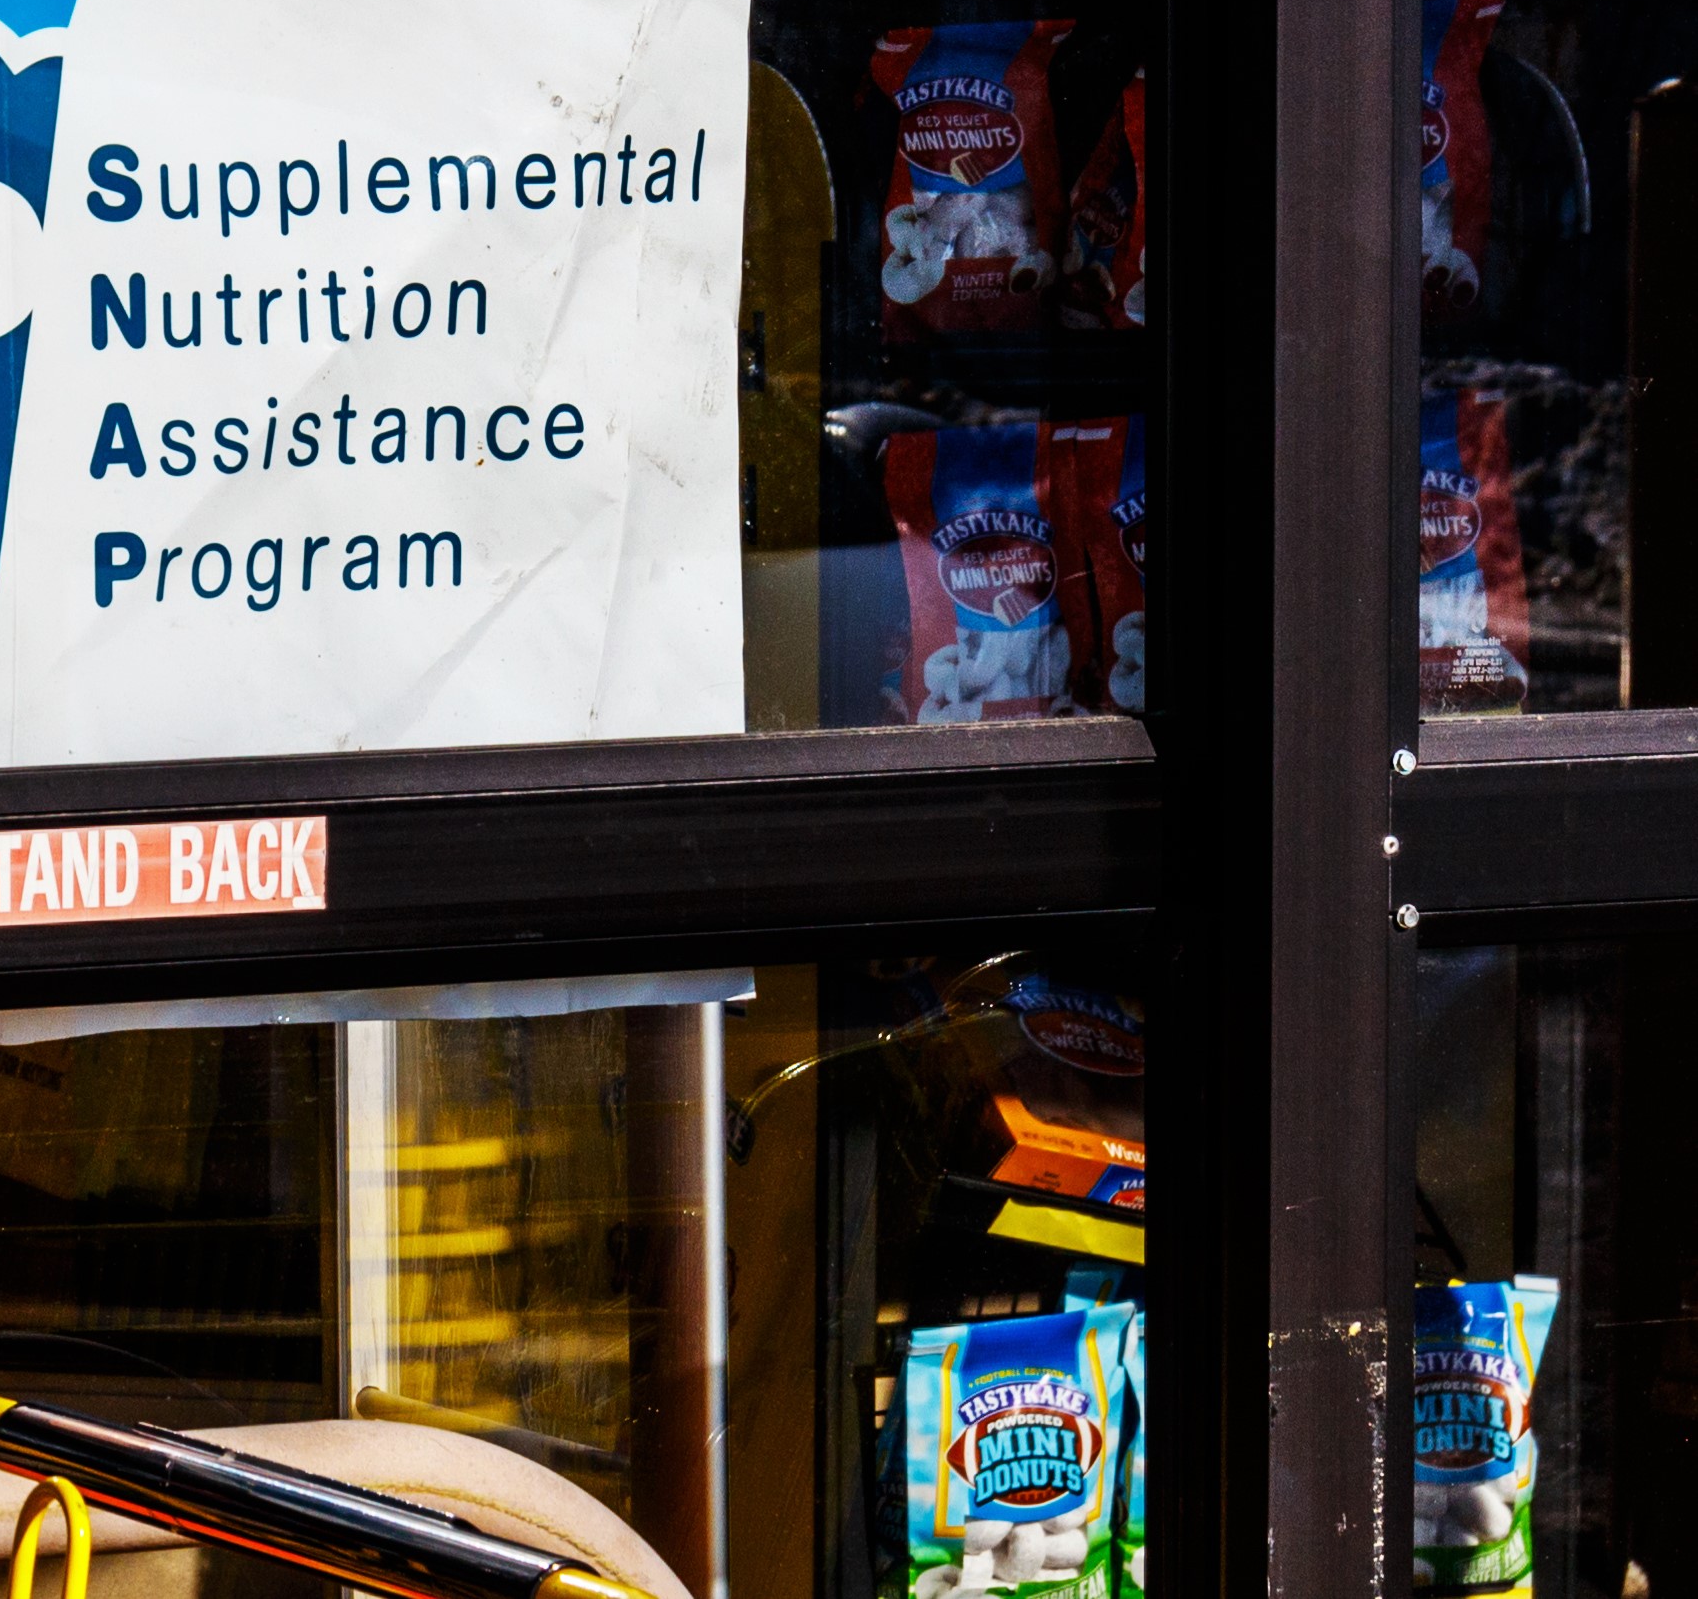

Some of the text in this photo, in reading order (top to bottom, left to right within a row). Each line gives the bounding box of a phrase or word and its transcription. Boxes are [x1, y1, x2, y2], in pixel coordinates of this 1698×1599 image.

[893, 77, 1010, 112] TASTYKAKE
[904, 126, 1016, 152] MINI DONUTS
[916, 112, 990, 128] RED VELVET
[86, 129, 706, 237] Supplemental
[952, 271, 1004, 288] WINTER
[90, 266, 488, 351] Nutrition
[89, 393, 586, 479] Assistance
[934, 512, 1051, 550] TASTYKAKE
[94, 531, 462, 612] Program
[951, 562, 1052, 590] MINI DONUTS
[169, 818, 317, 905] BACK
[960, 1383, 1087, 1424] TASTYKAKE
[987, 1413, 1064, 1434] POWDERED
[978, 1426, 1078, 1469] MINI
[974, 1458, 1084, 1505] DONUTS
